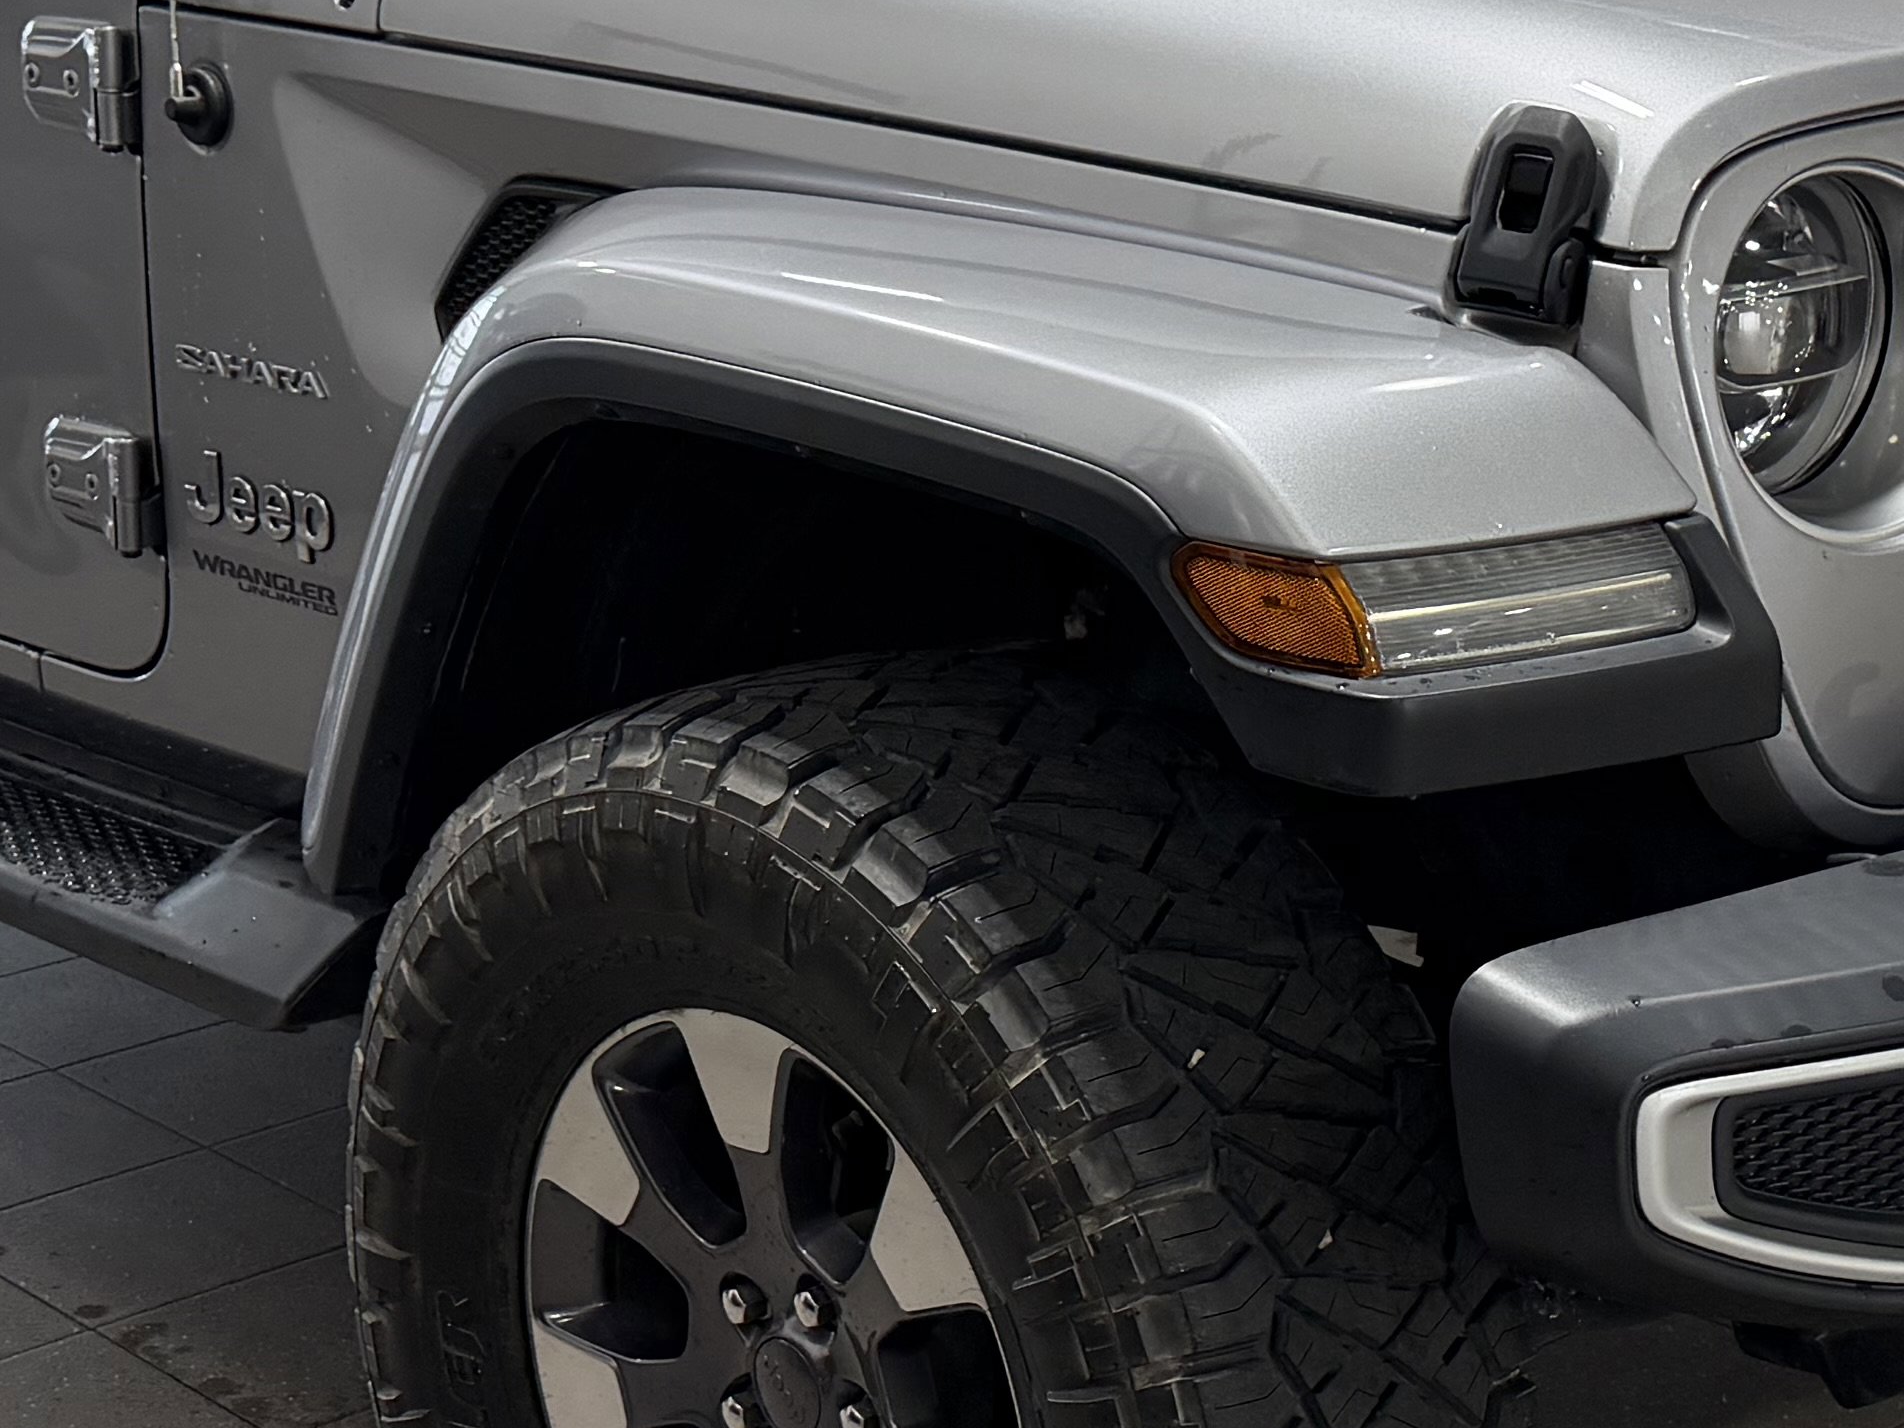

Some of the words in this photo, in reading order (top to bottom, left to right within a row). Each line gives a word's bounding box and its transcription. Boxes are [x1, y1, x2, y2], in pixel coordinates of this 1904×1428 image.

[175, 344, 330, 399] SAHARA
[184, 449, 336, 565] Jeep
[192, 548, 337, 606] WRANGLER
[237, 581, 339, 617] UNLIMITED
